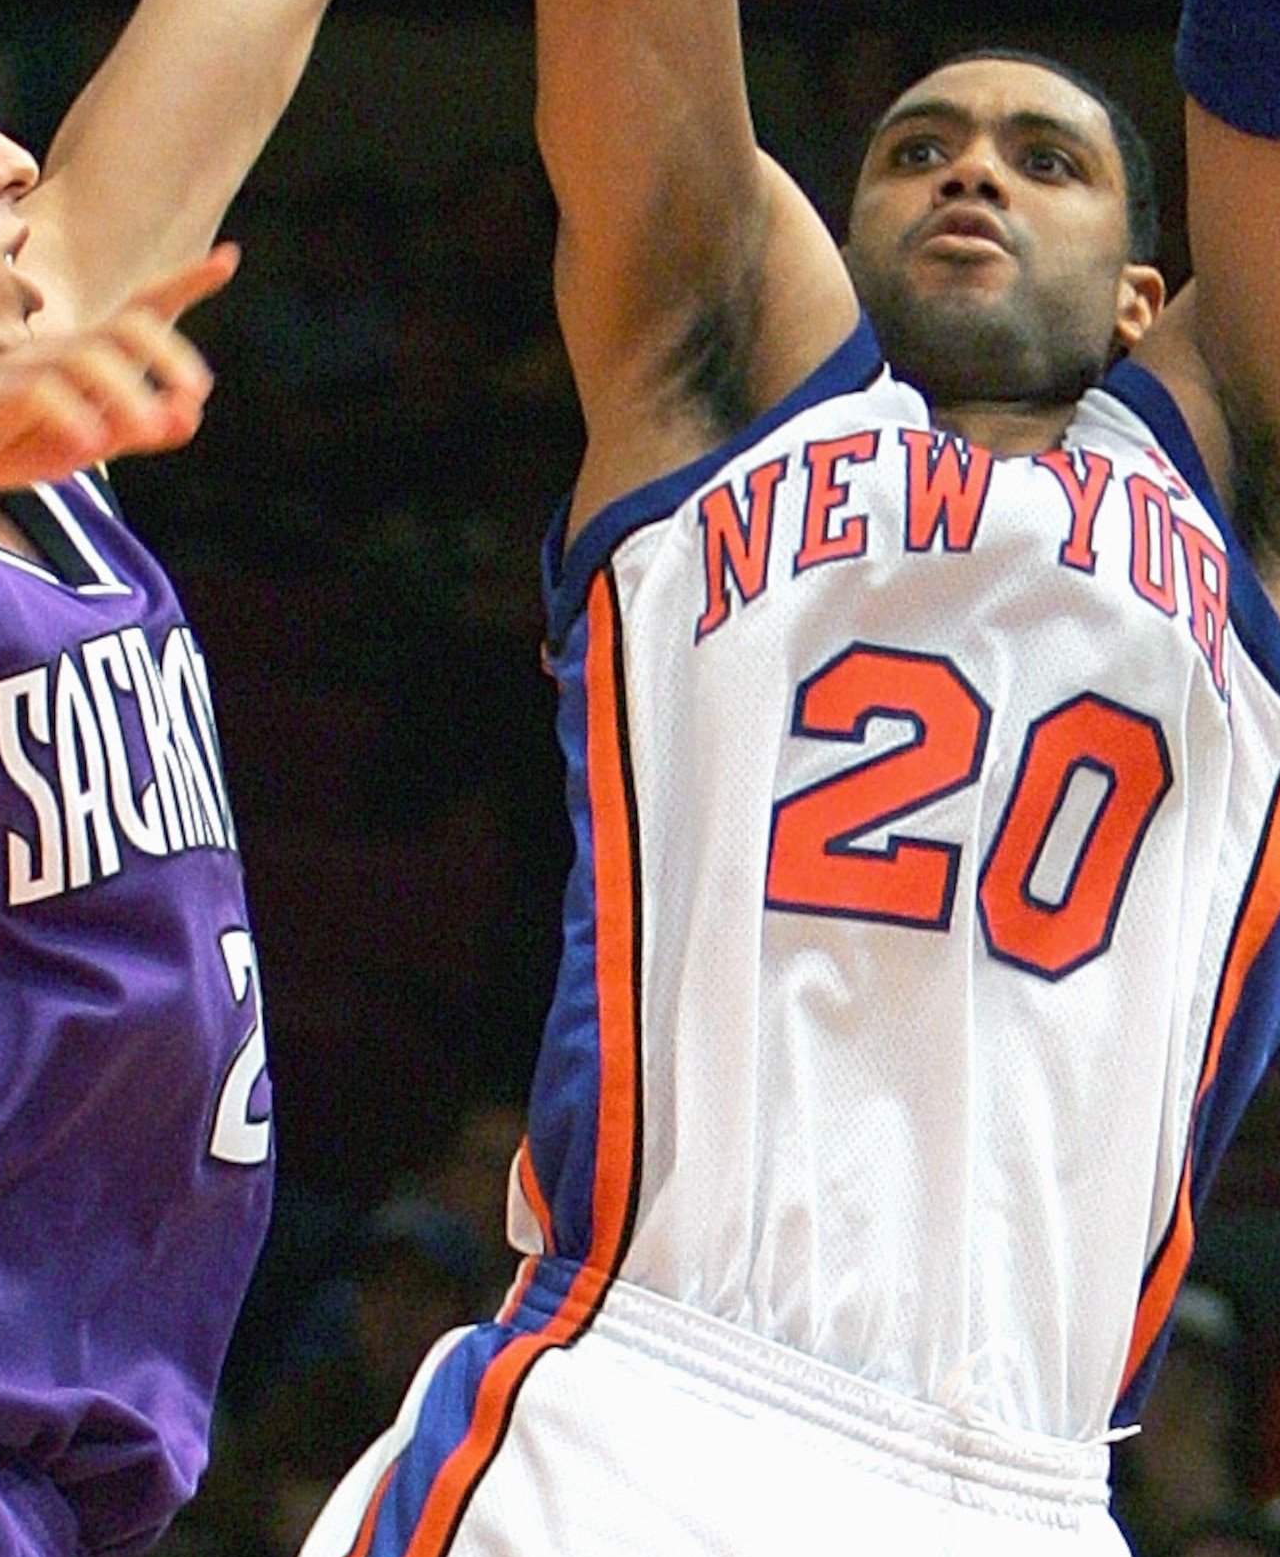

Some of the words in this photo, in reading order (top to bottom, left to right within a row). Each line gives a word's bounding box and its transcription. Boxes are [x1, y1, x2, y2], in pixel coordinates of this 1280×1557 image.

[694, 428, 993, 645] NEW
[764, 640, 1174, 984] 20
[210, 929, 273, 1166] 2
